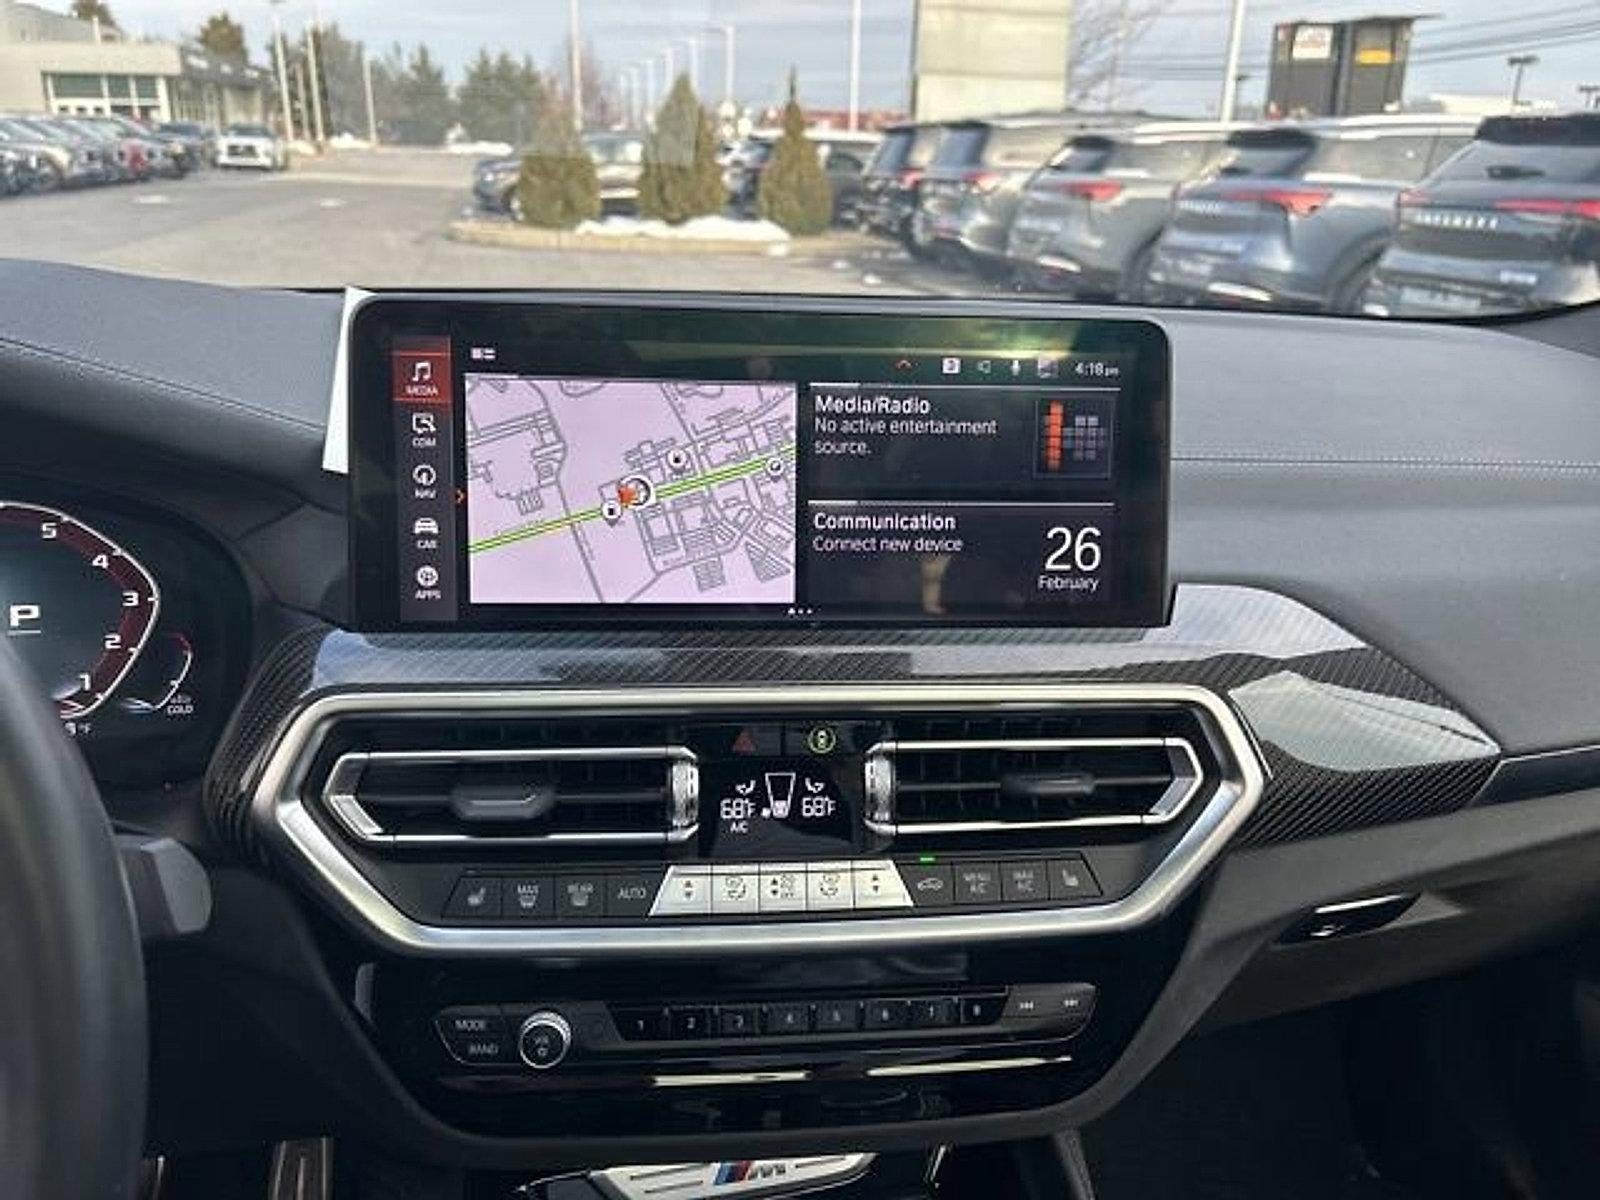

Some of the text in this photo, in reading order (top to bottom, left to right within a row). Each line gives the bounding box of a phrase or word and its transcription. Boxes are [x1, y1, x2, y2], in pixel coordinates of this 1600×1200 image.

[405, 385, 438, 396] MEDIA
[814, 396, 931, 415] Media/Radio
[814, 418, 997, 434] No active entertainment
[412, 437, 436, 447] COM
[814, 440, 872, 454] source.
[415, 489, 436, 499] NAV
[813, 513, 955, 530] Communication
[41, 523, 57, 539] 5
[417, 540, 437, 549] CAR
[812, 536, 963, 552] Connect new device
[1044, 526, 1101, 572] 26
[92, 554, 109, 569] 4
[1038, 575, 1099, 592] February
[122, 591, 139, 607] 3
[415, 590, 441, 599] APPS
[9, 604, 40, 627] P
[105, 633, 121, 649] 2
[80, 674, 90, 690] 1
[167, 704, 194, 716] COLD
[617, 887, 647, 899] AUTO
[455, 1019, 486, 1031] MODE
[687, 1016, 696, 1029] 2
